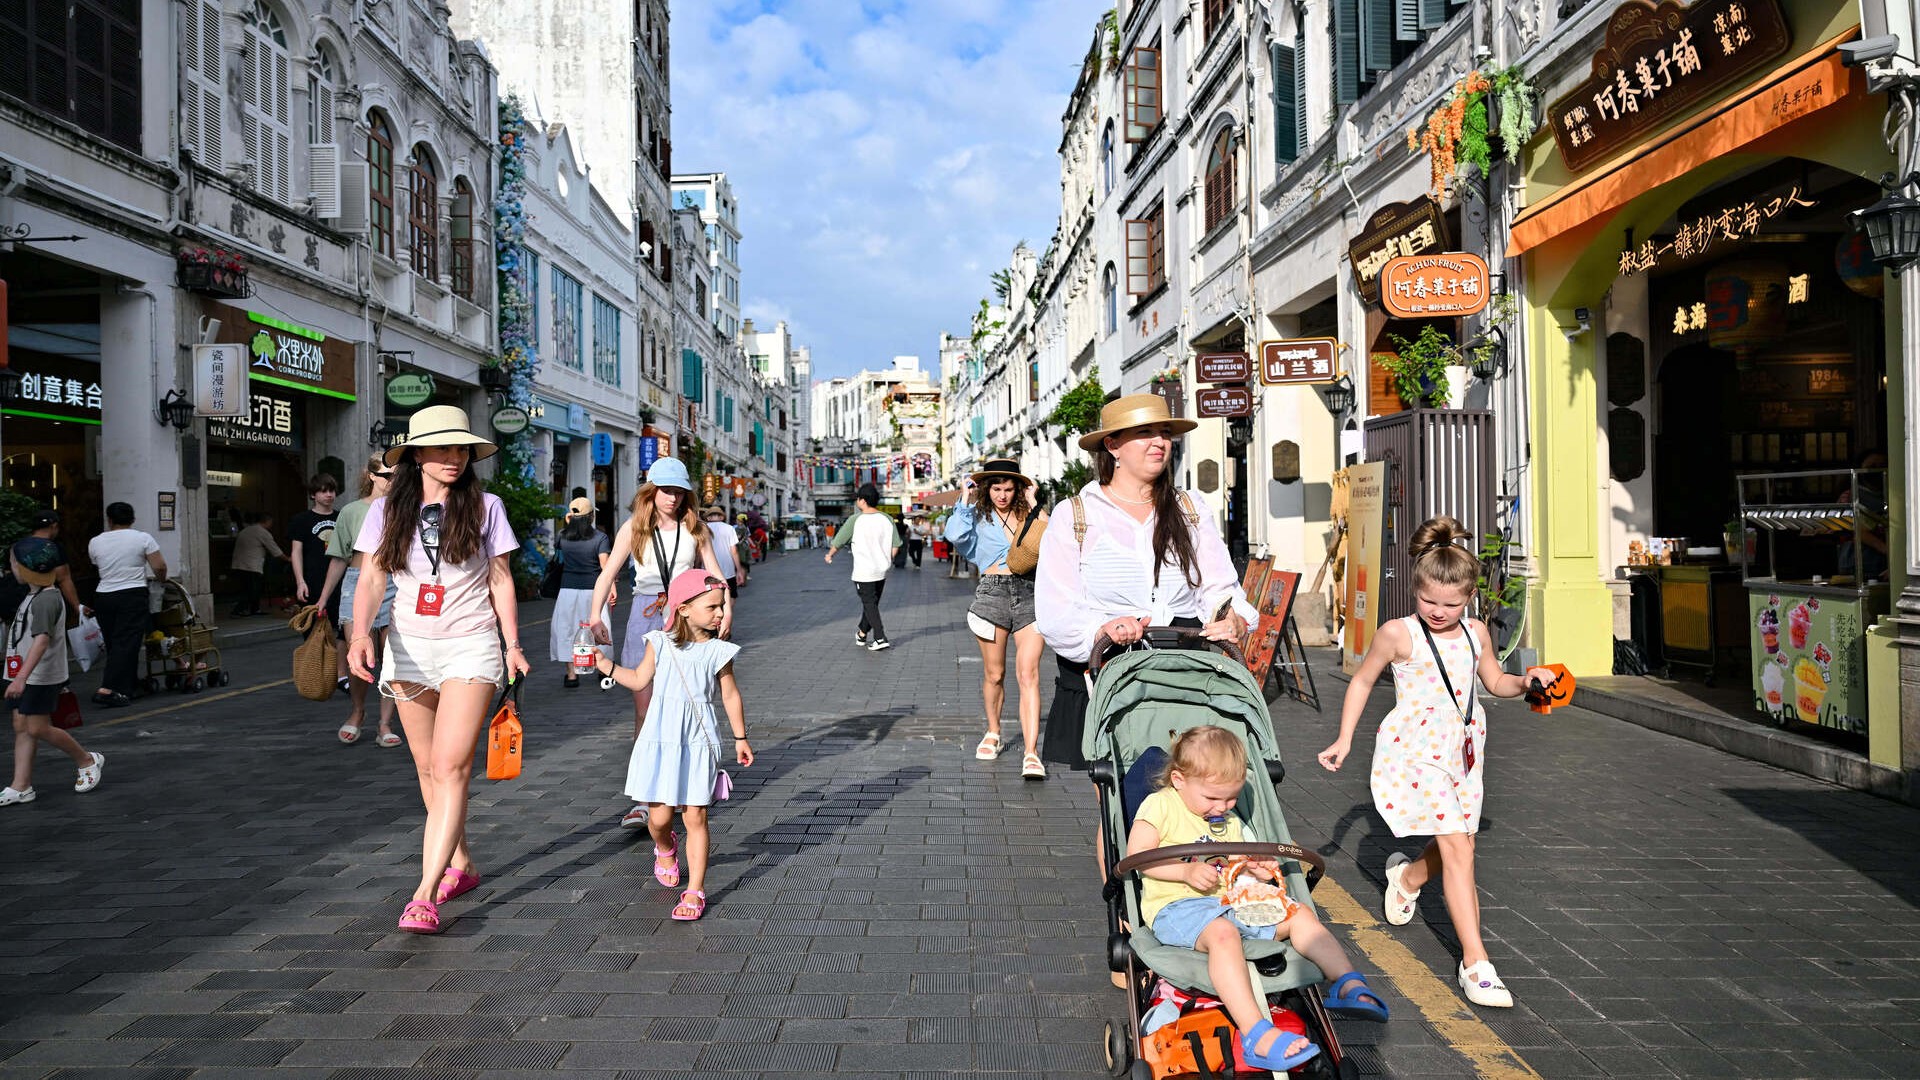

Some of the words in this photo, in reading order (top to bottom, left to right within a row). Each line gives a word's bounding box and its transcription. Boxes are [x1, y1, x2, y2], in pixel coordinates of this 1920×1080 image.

[1619, 187, 1815, 275] 椒盐一蘸秒变海口人
[1405, 260, 1436, 275] ACHUN
[1438, 260, 1465, 273] FRUIT
[1270, 359, 1329, 377] 山兰酒
